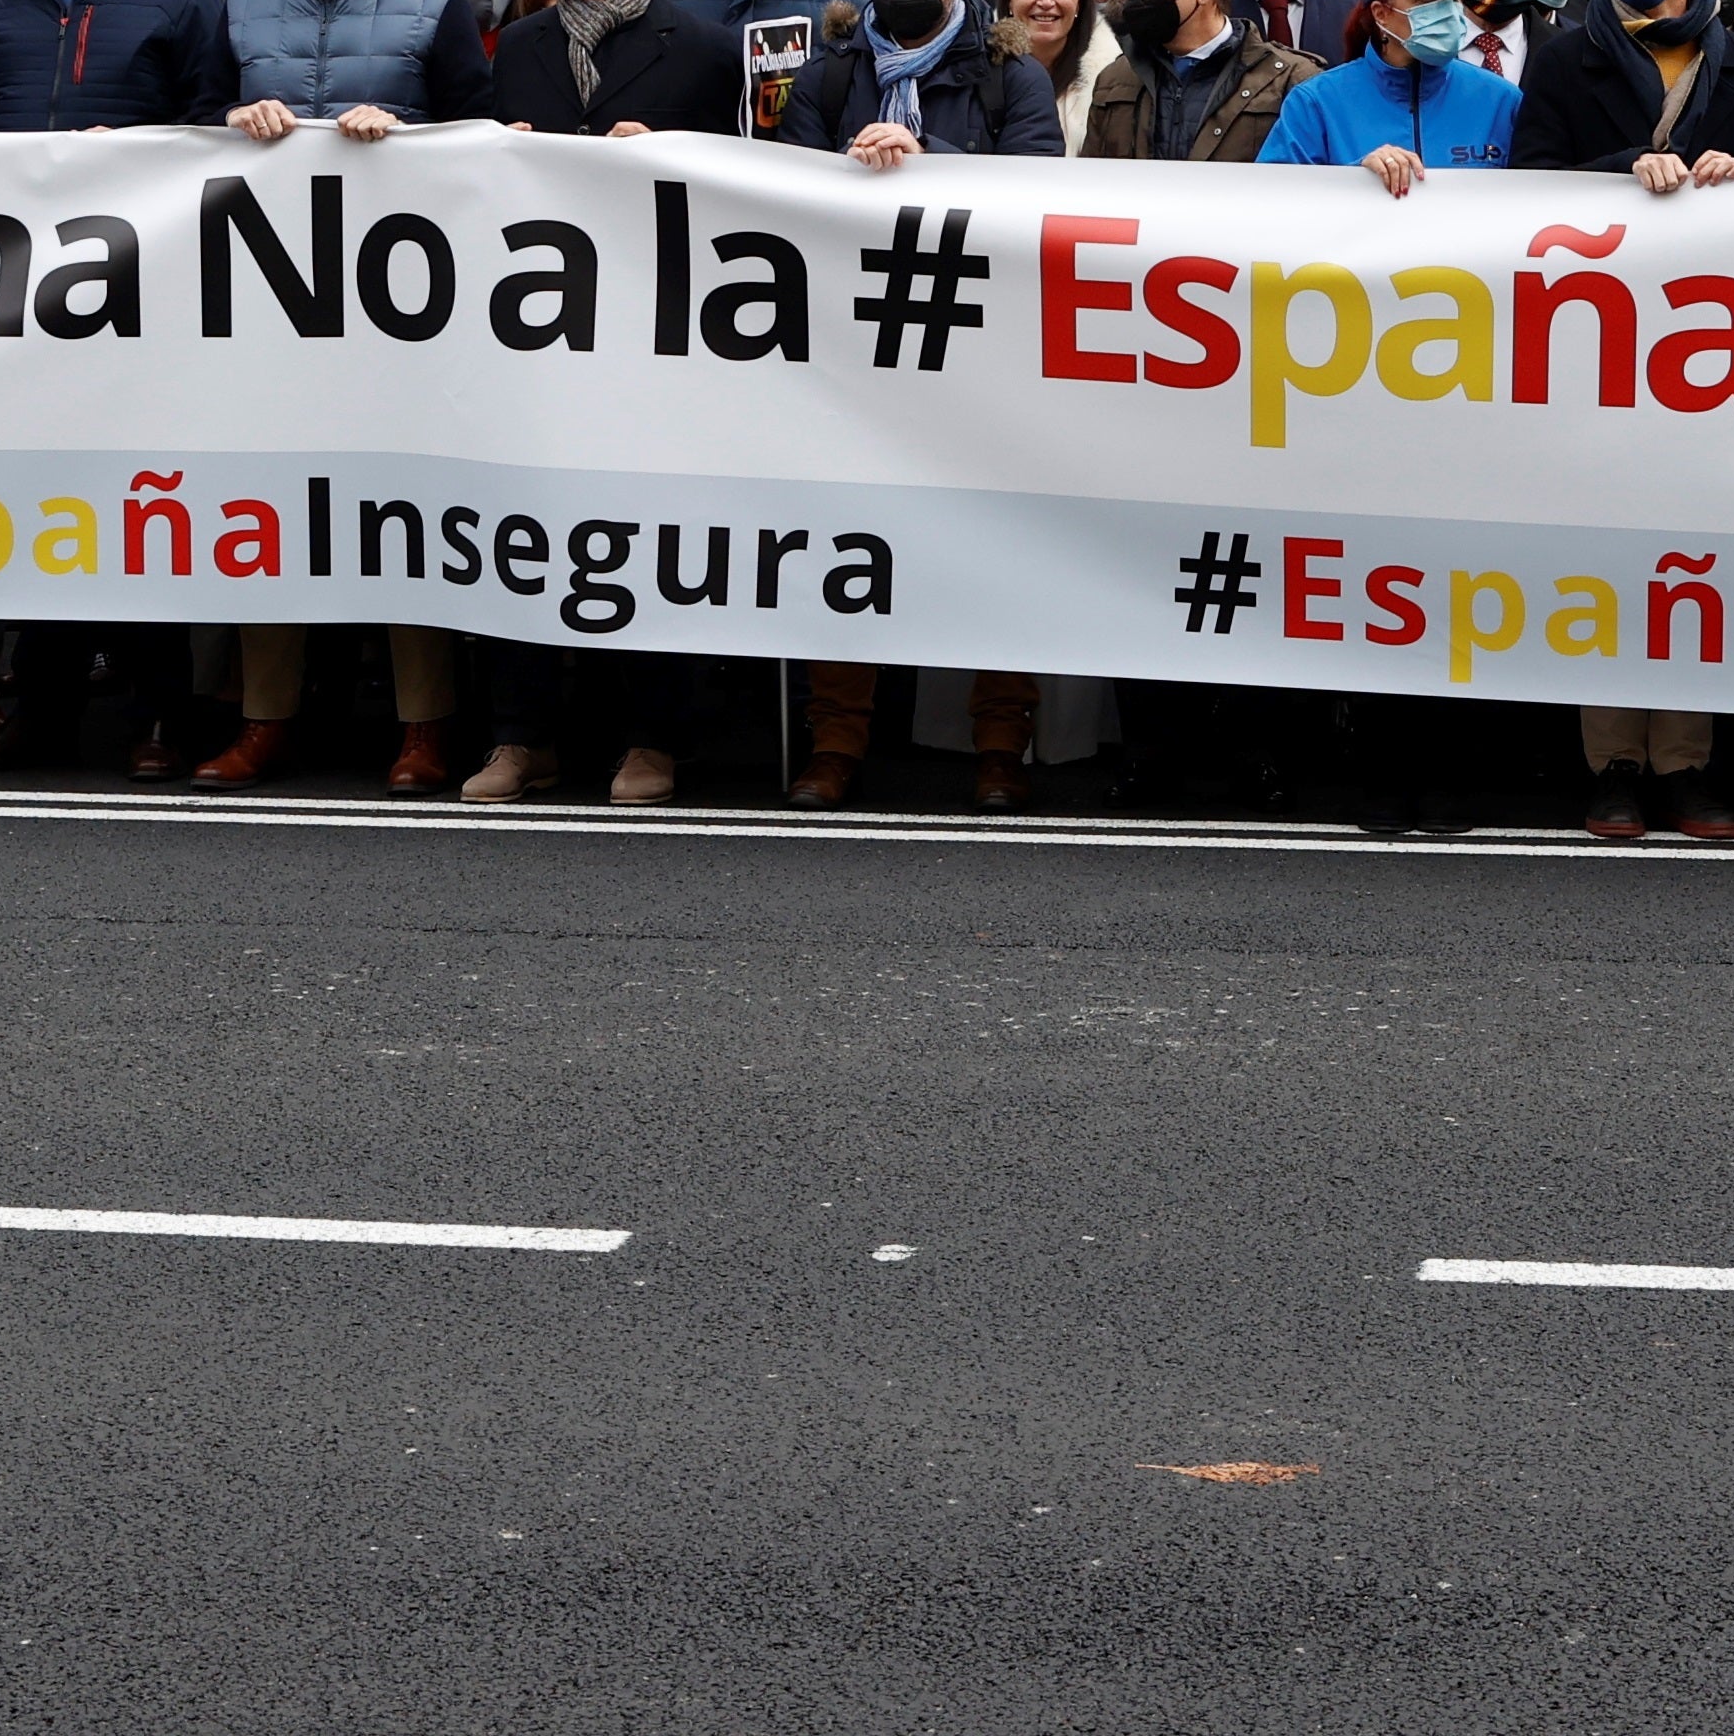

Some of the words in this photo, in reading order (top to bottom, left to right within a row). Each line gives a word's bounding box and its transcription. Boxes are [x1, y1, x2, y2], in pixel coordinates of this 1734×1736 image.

[1451, 144, 1501, 163] SUP
[200, 175, 455, 343] No
[489, 220, 598, 352] a
[654, 180, 810, 363] la
